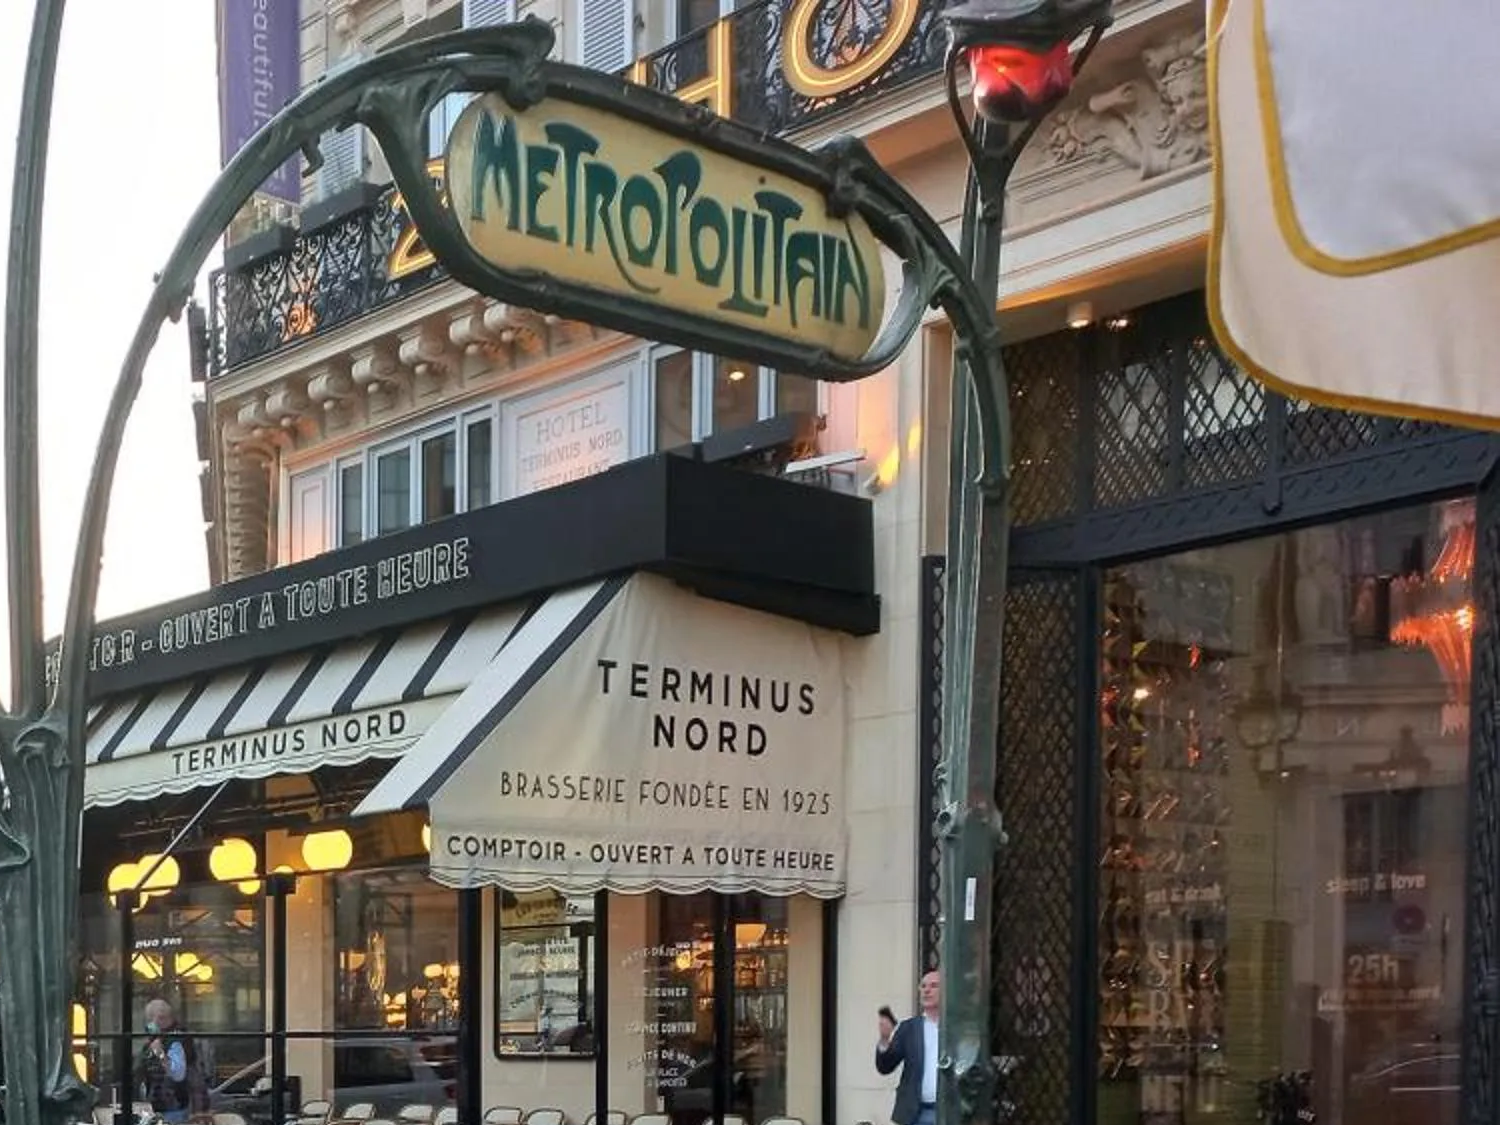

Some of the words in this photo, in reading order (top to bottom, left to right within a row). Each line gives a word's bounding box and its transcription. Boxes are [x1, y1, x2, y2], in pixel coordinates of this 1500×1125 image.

[471, 109, 870, 330] METROPOLITAIN
[589, 429, 623, 451] NORD
[159, 597, 250, 653] OUVERT
[258, 592, 276, 629] A
[284, 565, 368, 621] TOUTE
[377, 537, 470, 599] HEURE
[598, 659, 816, 716] TERMINUS
[172, 729, 306, 775] TERMINUS
[322, 709, 407, 748] NORD
[654, 714, 768, 757] NORD
[501, 770, 626, 804] BRASSERIE
[639, 778, 730, 810] FONDÉE
[743, 787, 770, 812] EN
[783, 789, 831, 816] 1925
[447, 835, 566, 862] COMPTOIR
[590, 843, 675, 866] OUVERT
[682, 847, 696, 865] A
[704, 846, 766, 868] TOUTE
[773, 849, 836, 872] HEURE
